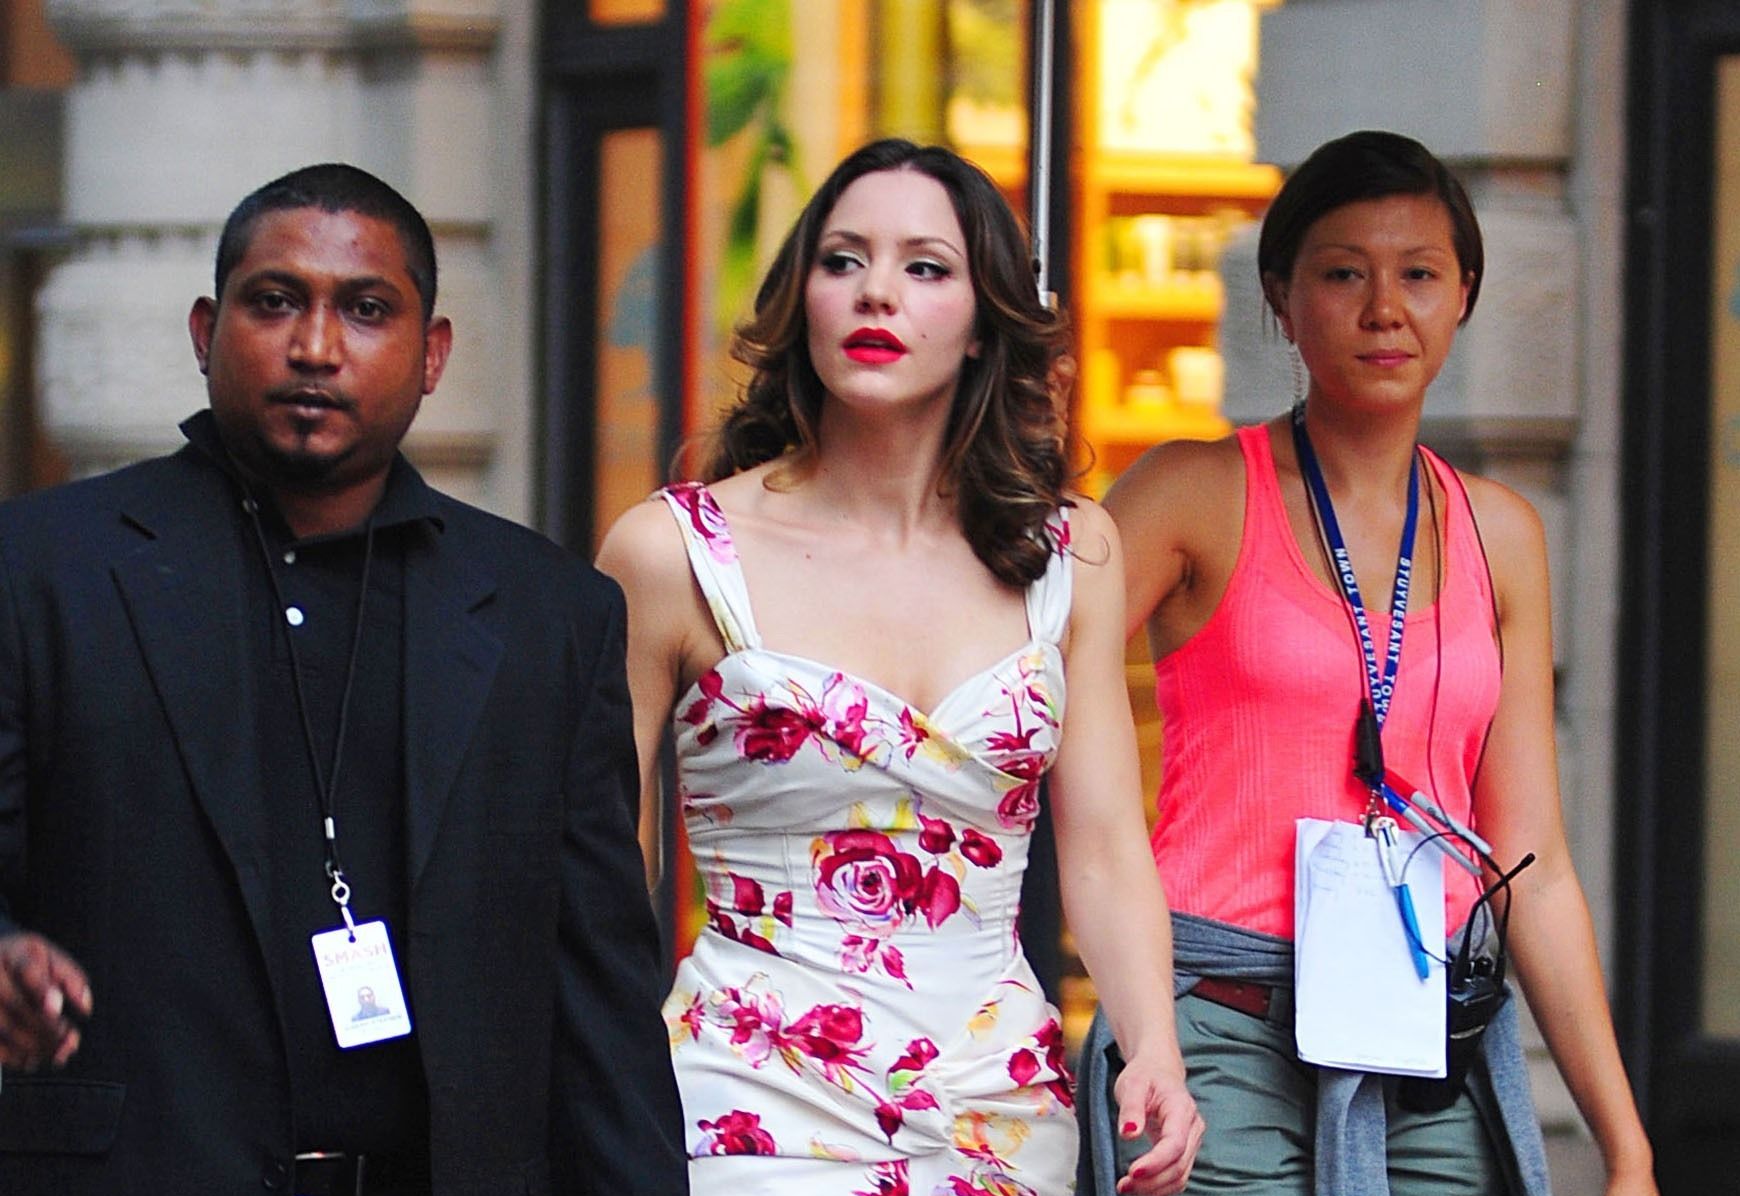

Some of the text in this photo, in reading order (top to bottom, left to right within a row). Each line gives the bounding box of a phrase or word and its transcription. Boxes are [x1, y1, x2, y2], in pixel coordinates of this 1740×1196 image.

[1334, 547, 1358, 595] TOWN
[1387, 557, 1411, 663] STUYVESANT
[323, 943, 387, 967] SMASH
